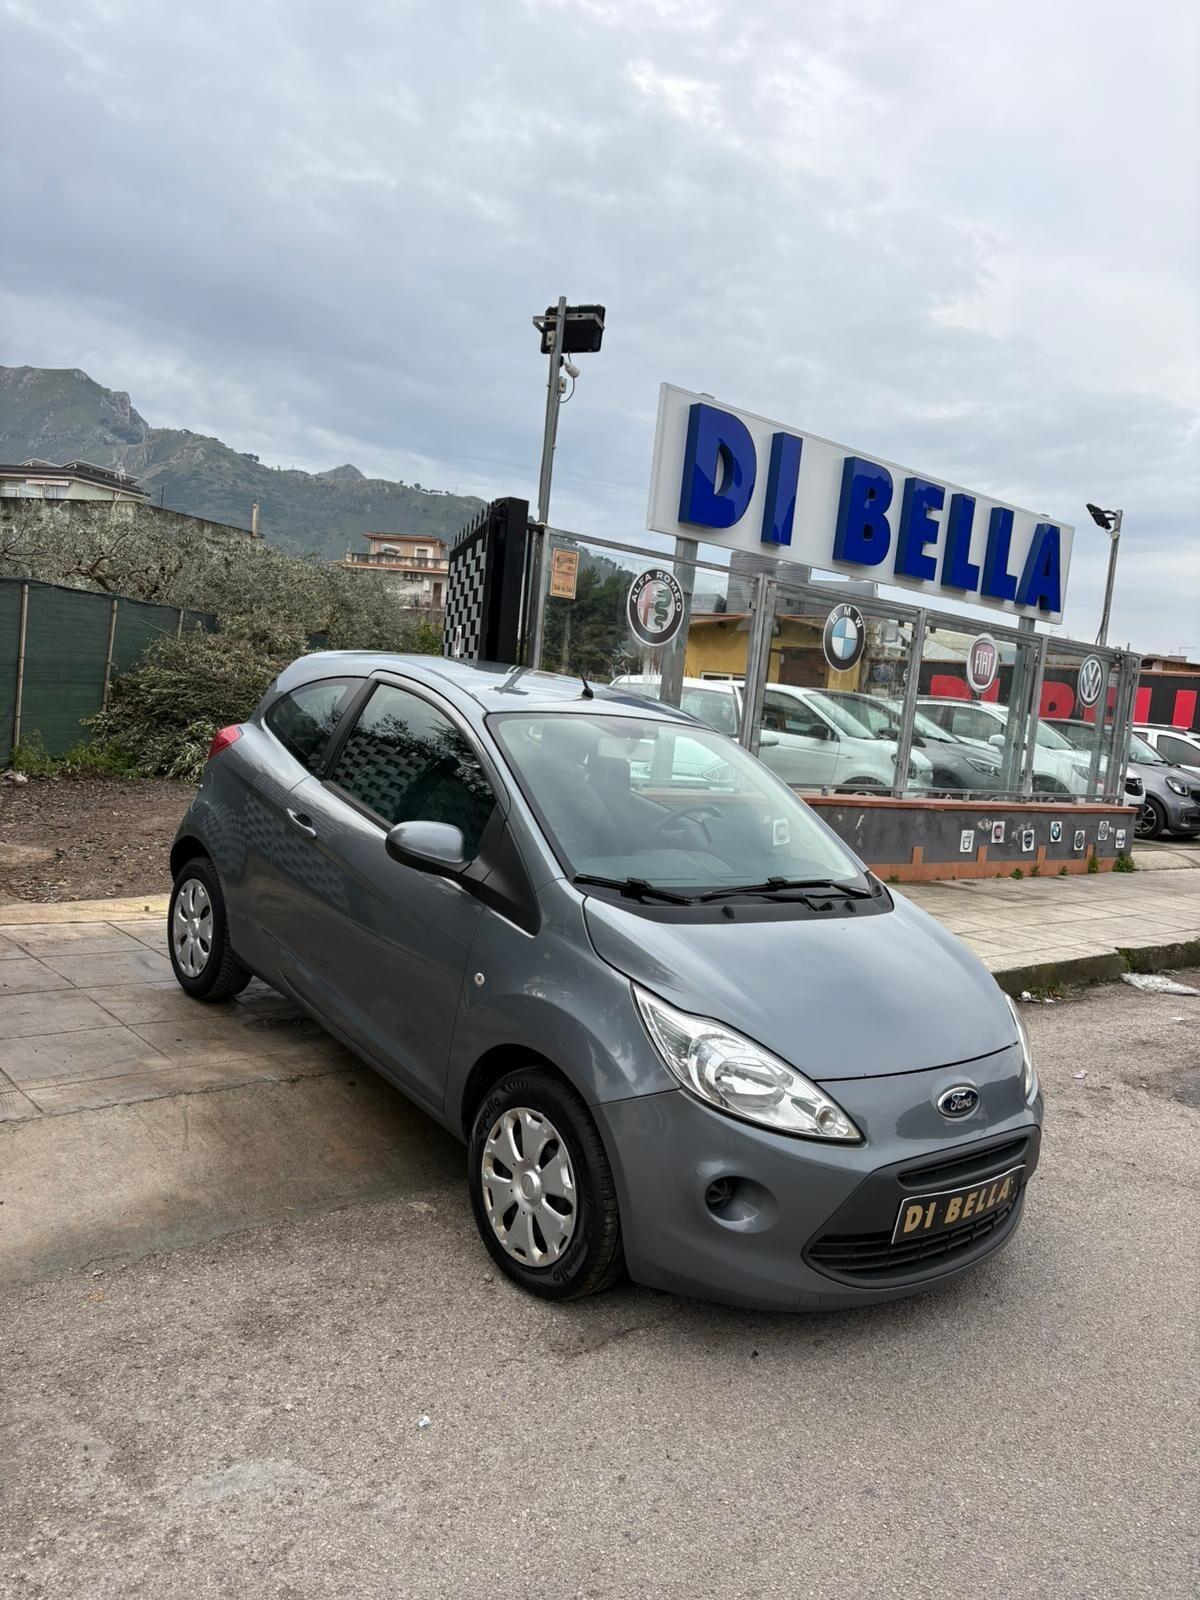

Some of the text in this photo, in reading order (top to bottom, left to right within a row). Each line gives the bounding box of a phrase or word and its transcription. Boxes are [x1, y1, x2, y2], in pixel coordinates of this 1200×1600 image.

[678, 402, 1061, 613] DI BELLA
[631, 571, 682, 612] ALFA ROMEO
[830, 606, 863, 628] BMW
[974, 650, 993, 677] FIAT
[950, 1092, 972, 1111] Ford
[903, 1177, 1011, 1233] DI BELLA
